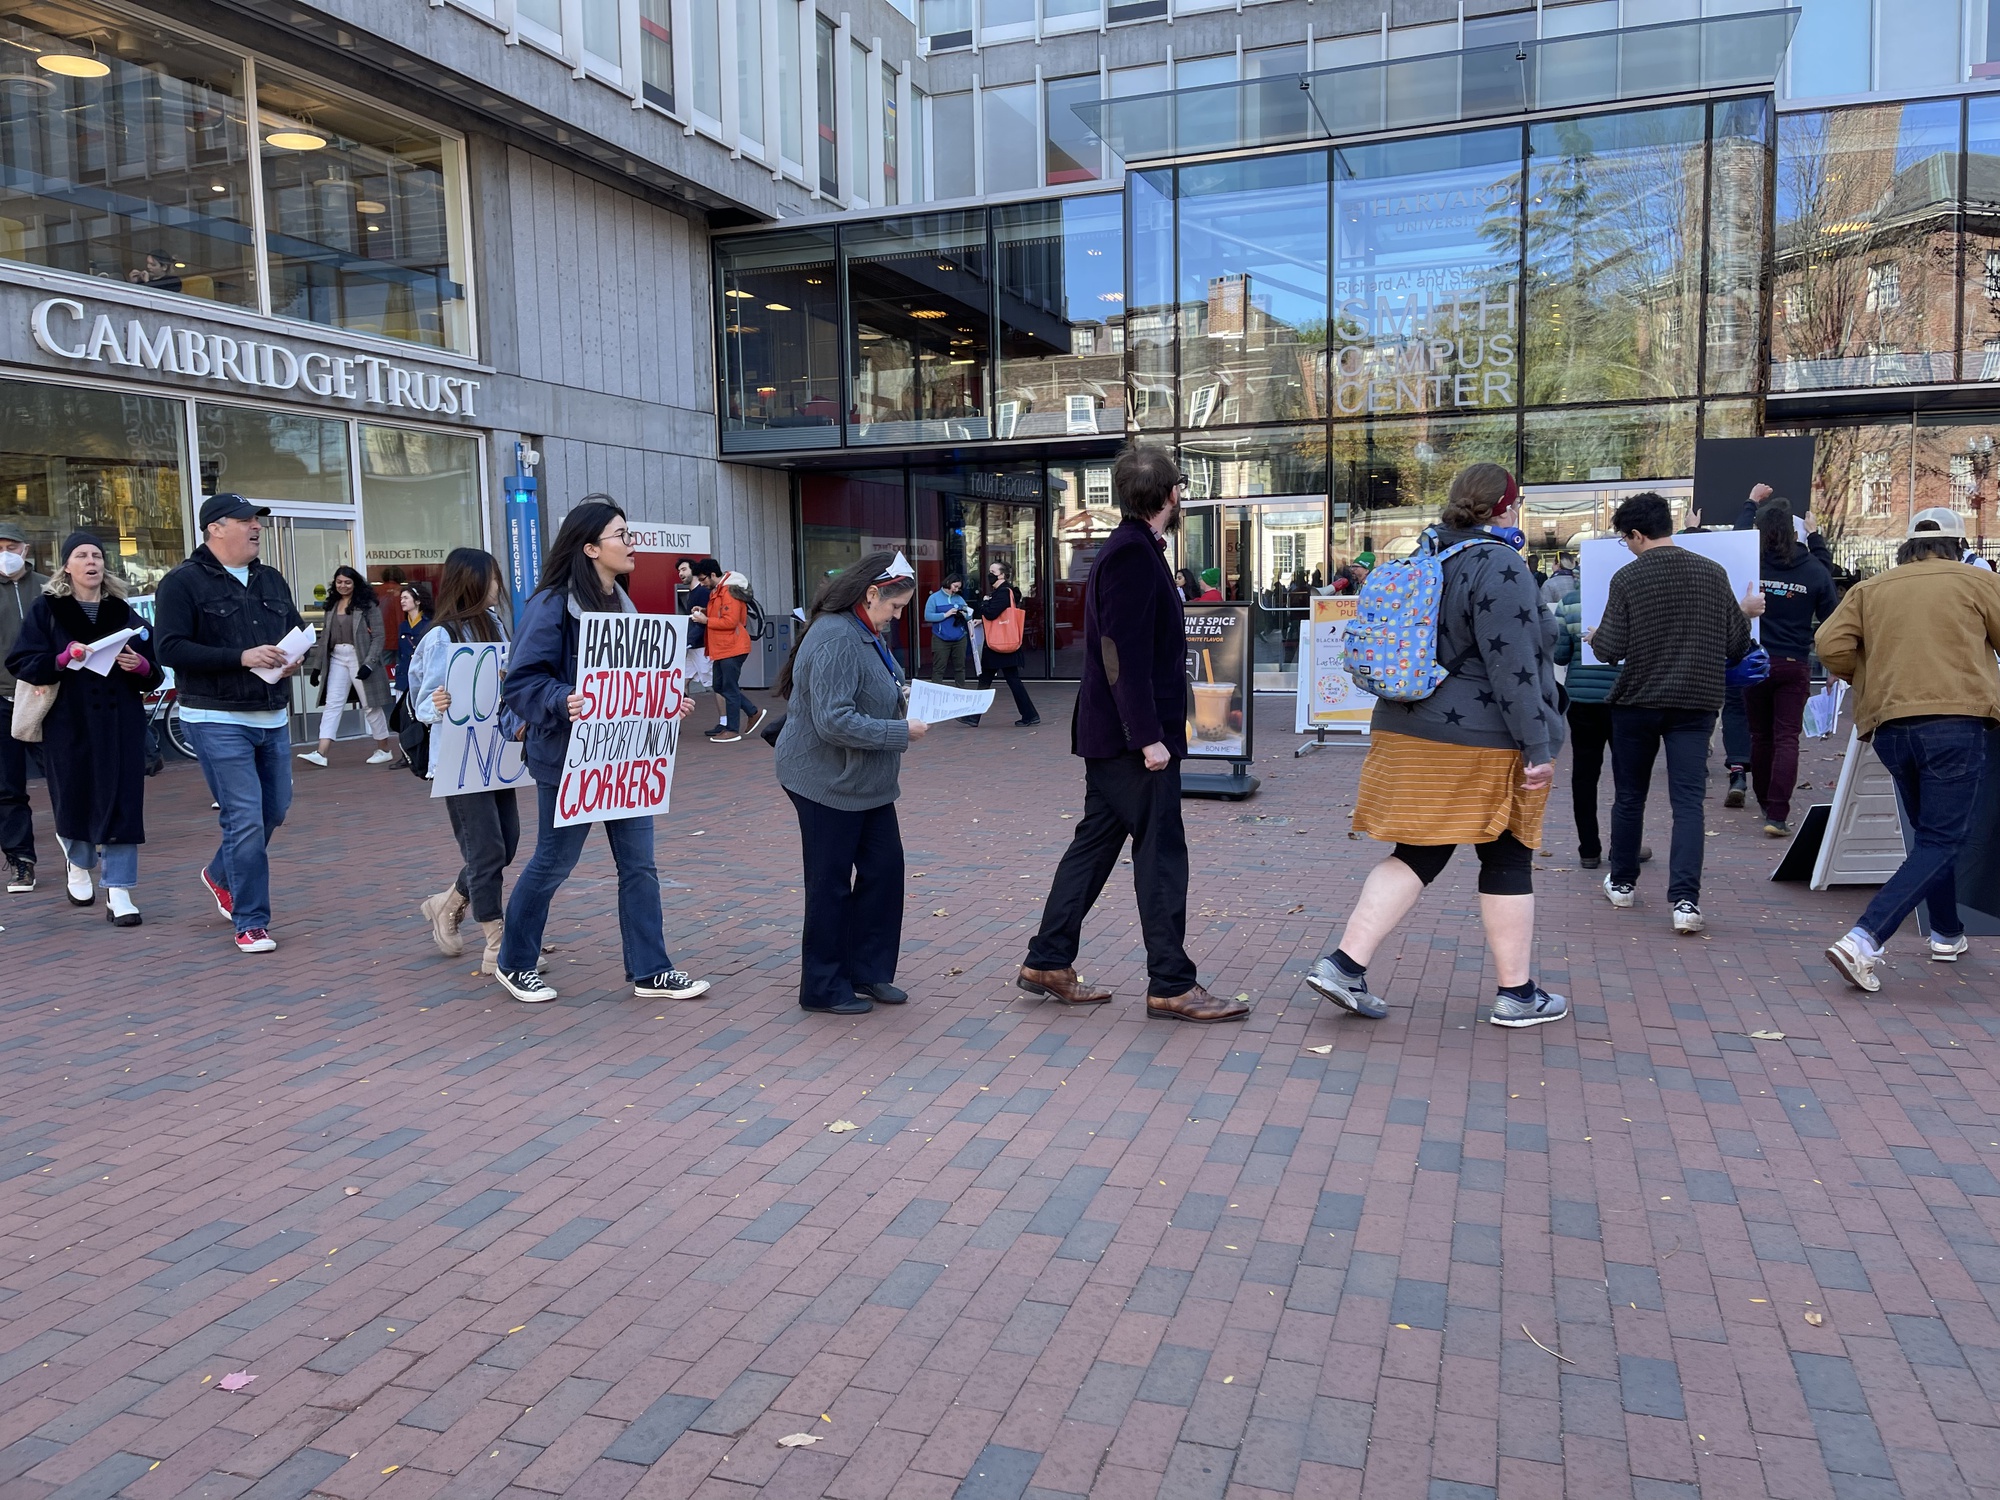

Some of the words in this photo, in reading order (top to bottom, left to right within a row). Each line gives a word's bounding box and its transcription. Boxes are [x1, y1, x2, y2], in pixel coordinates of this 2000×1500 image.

[1372, 184, 1512, 217] HARVARD
[1395, 213, 1487, 233] UNIVERSITY
[1336, 277, 1392, 295] Richard
[1395, 277, 1411, 291] A.
[1416, 271, 1443, 288] and
[1337, 284, 1516, 341] SMITH
[1337, 333, 1515, 377] CAMPUS
[1337, 371, 1513, 413] CENTER
[511, 519, 522, 592] EMERGENCY
[530, 519, 539, 587] EMERGENC
[658, 530, 691, 547] TRUST
[584, 617, 677, 669] HARVARD
[1184, 616, 1197, 626] IN
[1198, 616, 1205, 626] 5
[1206, 616, 1236, 626] SPICE
[1203, 625, 1222, 635] TEA
[579, 668, 682, 720] STUDENTS
[569, 720, 638, 768] SUPPORT
[636, 720, 678, 759] UNION
[559, 758, 667, 820] WORKERS
